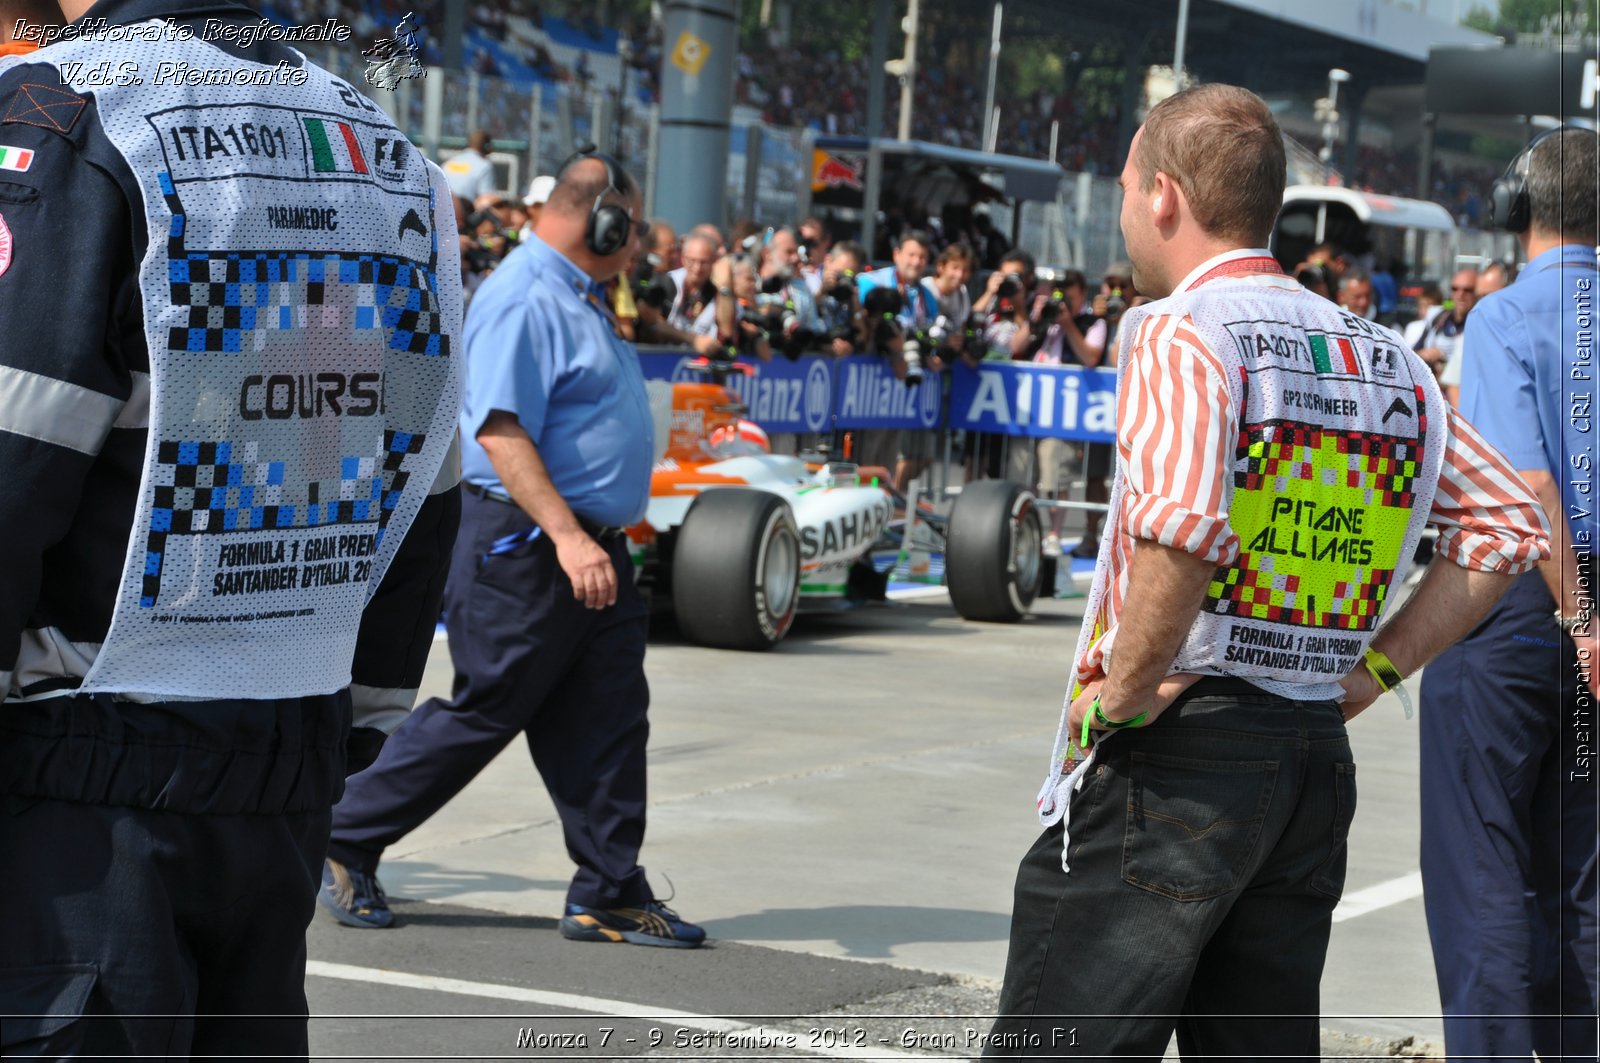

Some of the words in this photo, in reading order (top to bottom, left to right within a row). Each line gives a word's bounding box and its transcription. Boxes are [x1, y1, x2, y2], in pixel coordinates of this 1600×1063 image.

[170, 122, 288, 161] ITA1601
[267, 205, 338, 231] PARAMEDIC
[1238, 333, 1311, 362] ITA2073
[1283, 389, 1303, 408] GP2
[217, 540, 285, 568] FORMULA
[290, 539, 300, 562] 1
[303, 536, 338, 562] GRAN
[212, 566, 299, 597] SANTANDER
[300, 563, 350, 588] D'ITALIA
[1230, 625, 1294, 651] FORMULA
[1297, 635, 1305, 652] 1
[1305, 636, 1329, 655] GRAN
[1329, 637, 1362, 656] PREMIO
[1224, 645, 1301, 671] SANTANDER
